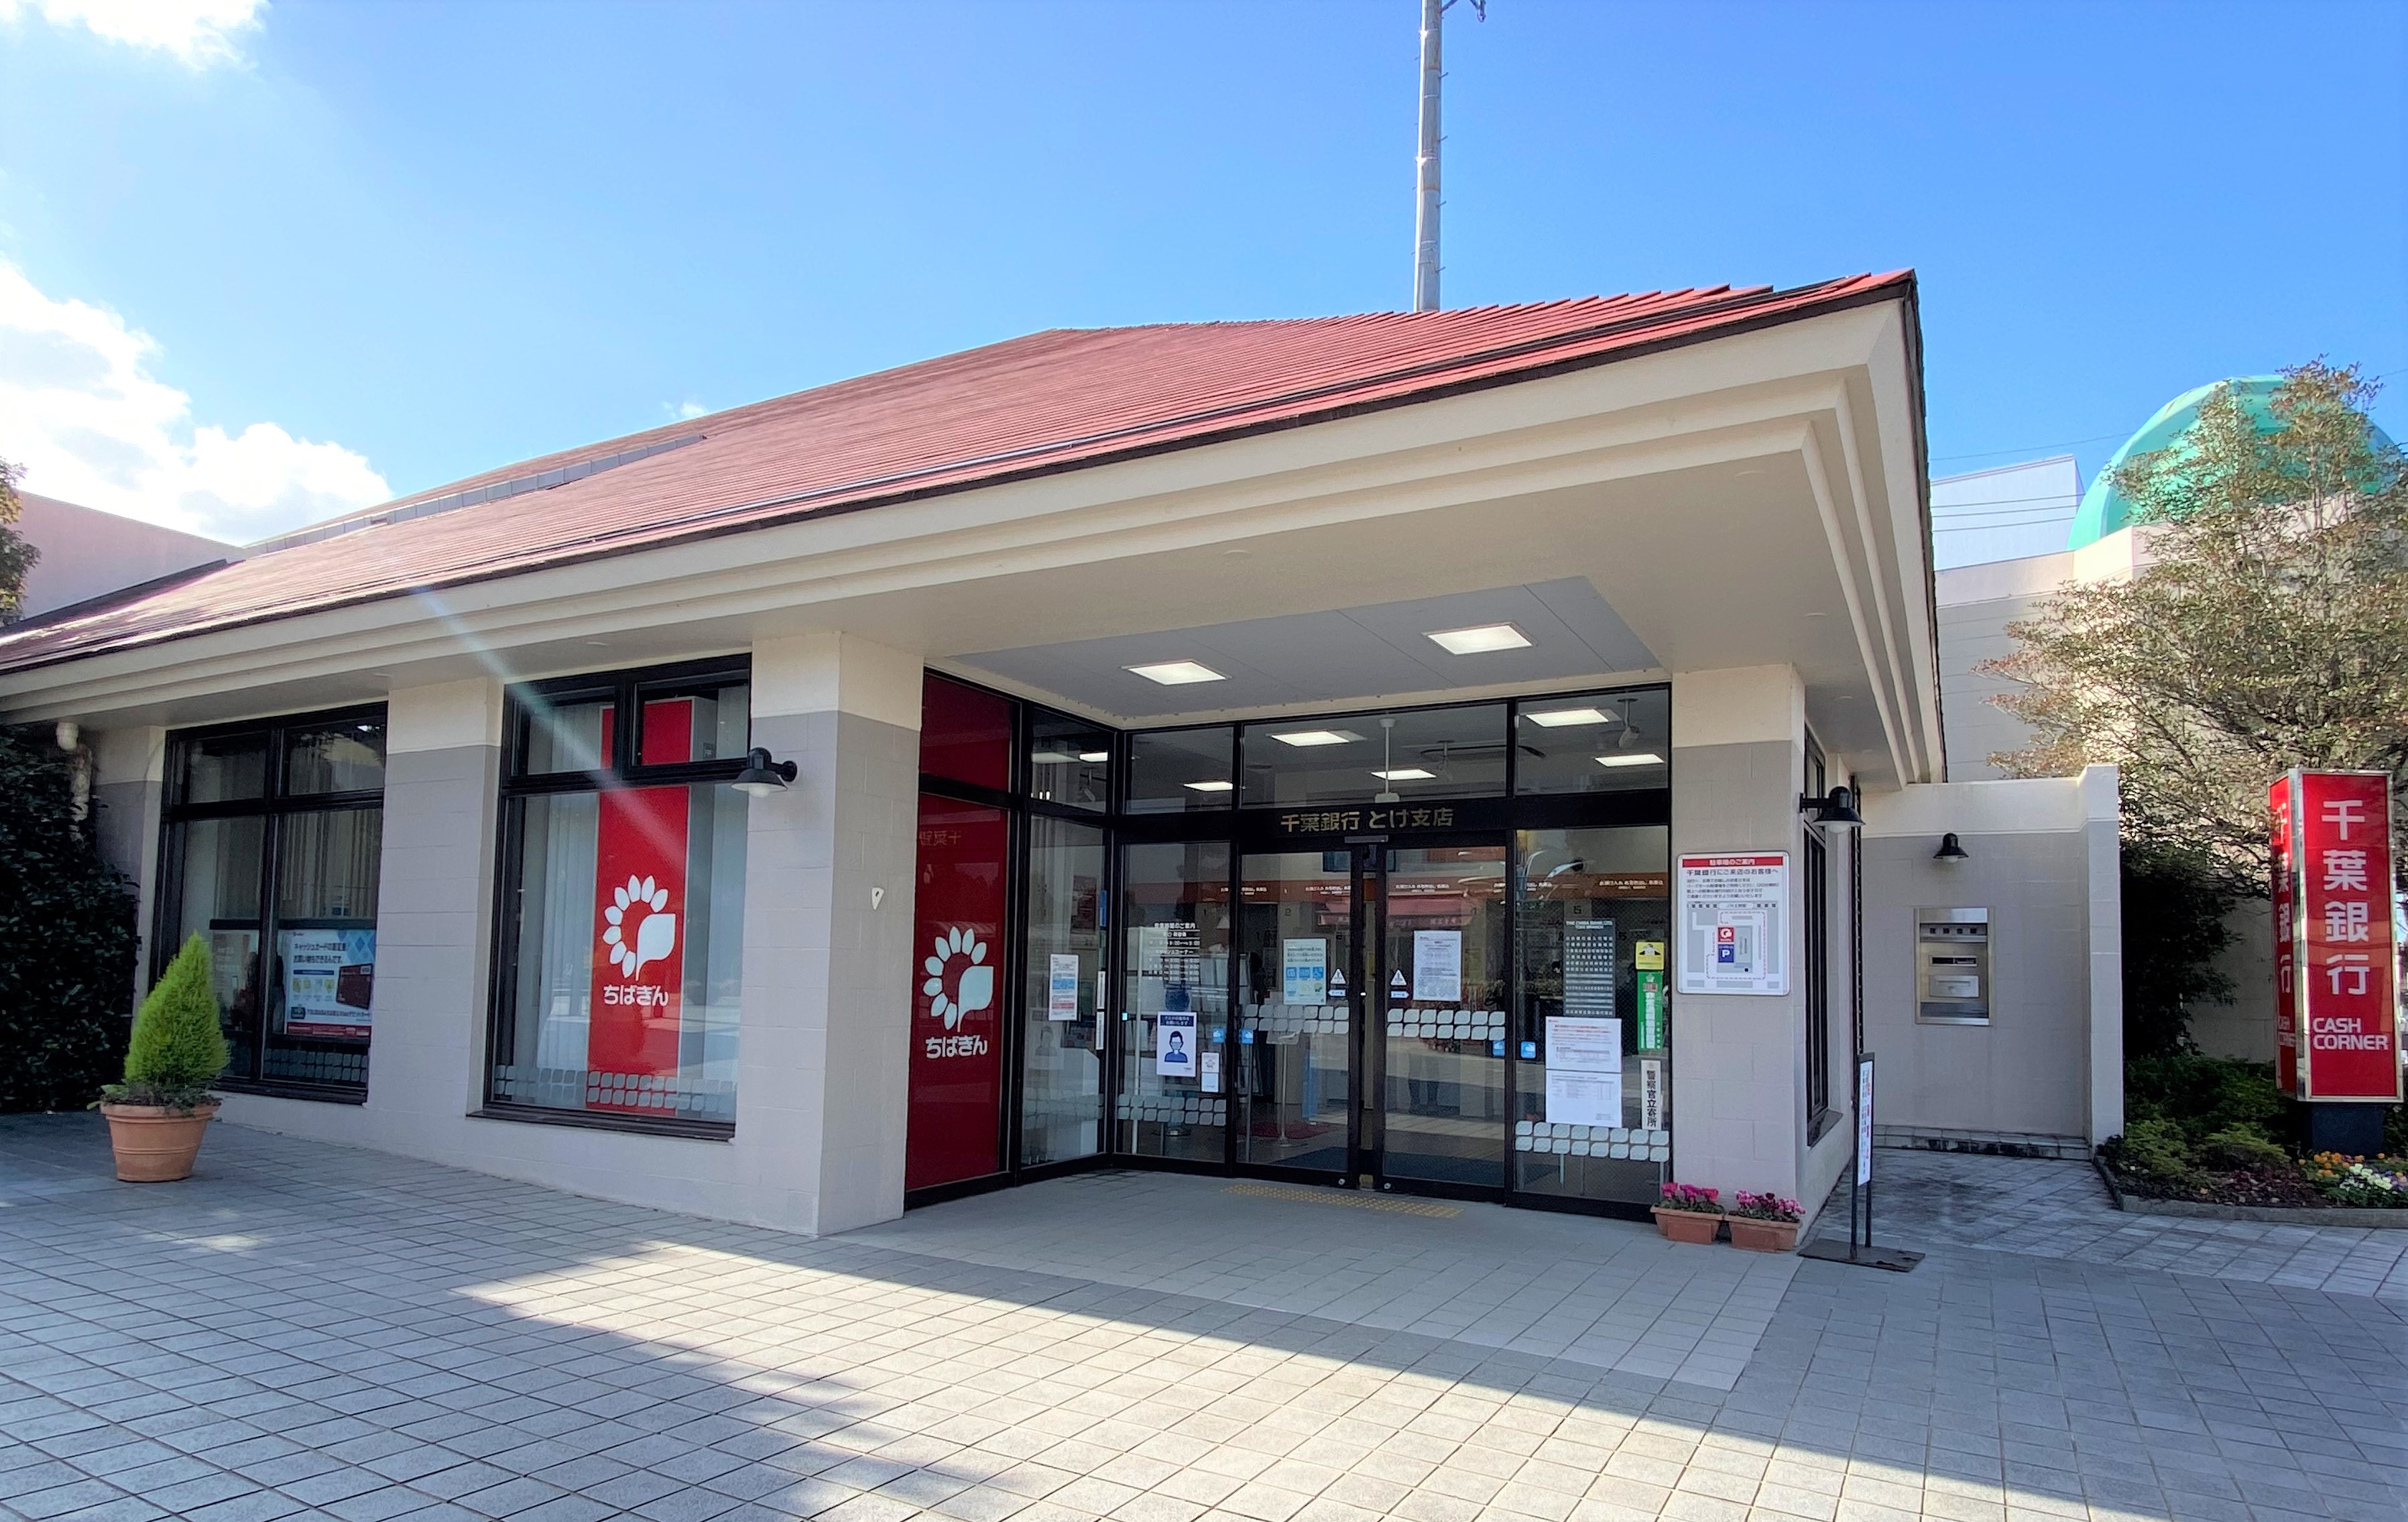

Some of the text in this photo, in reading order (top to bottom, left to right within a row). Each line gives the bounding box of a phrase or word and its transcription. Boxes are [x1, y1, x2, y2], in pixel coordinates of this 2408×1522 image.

[1280, 808, 1453, 832] 千葉銀行 とけ支店
[2322, 800, 2369, 994] 千葉銀行
[1722, 949, 1730, 957] P
[603, 984, 669, 1006] ちばぎん
[2313, 1017, 2361, 1033] CASH
[926, 1035, 987, 1058] ちばぎん
[2313, 1034, 2390, 1051] CORNER
[1647, 1070, 1657, 1127] 警察官立寄所
